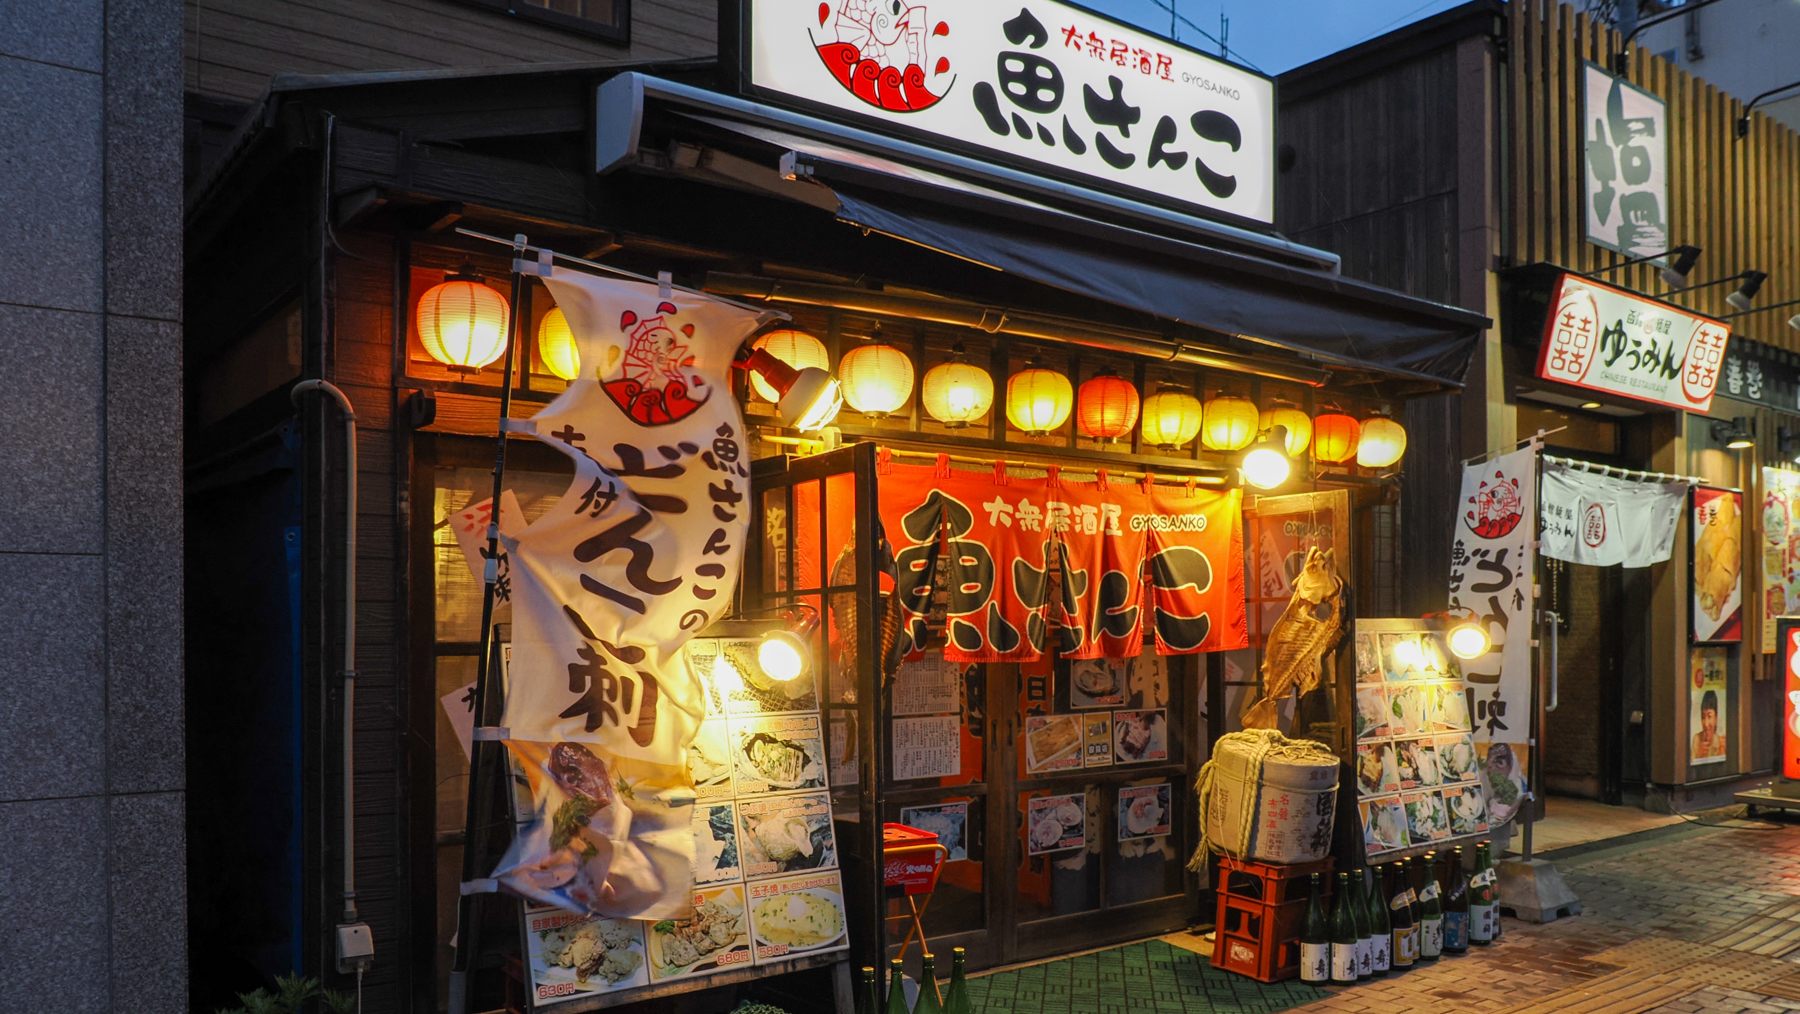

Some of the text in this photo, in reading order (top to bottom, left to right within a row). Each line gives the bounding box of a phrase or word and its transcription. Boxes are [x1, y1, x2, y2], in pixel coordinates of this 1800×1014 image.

[1061, 24, 1175, 84] 大衆居酒屋
[973, 7, 1242, 199] 魚さんこ
[1181, 70, 1241, 102] GYOSANKO
[1600, 318, 1685, 380] ゆうみん
[679, 422, 749, 632] 魚さんこの
[983, 495, 1123, 537] 大衆居酒屋
[1129, 513, 1208, 533] GYOSANKO
[895, 488, 1213, 656] 魚さんこ
[752, 884, 779, 898] 玉子焼
[717, 951, 749, 965] 680円
[758, 944, 788, 957] 580円
[538, 983, 576, 998] 630円
